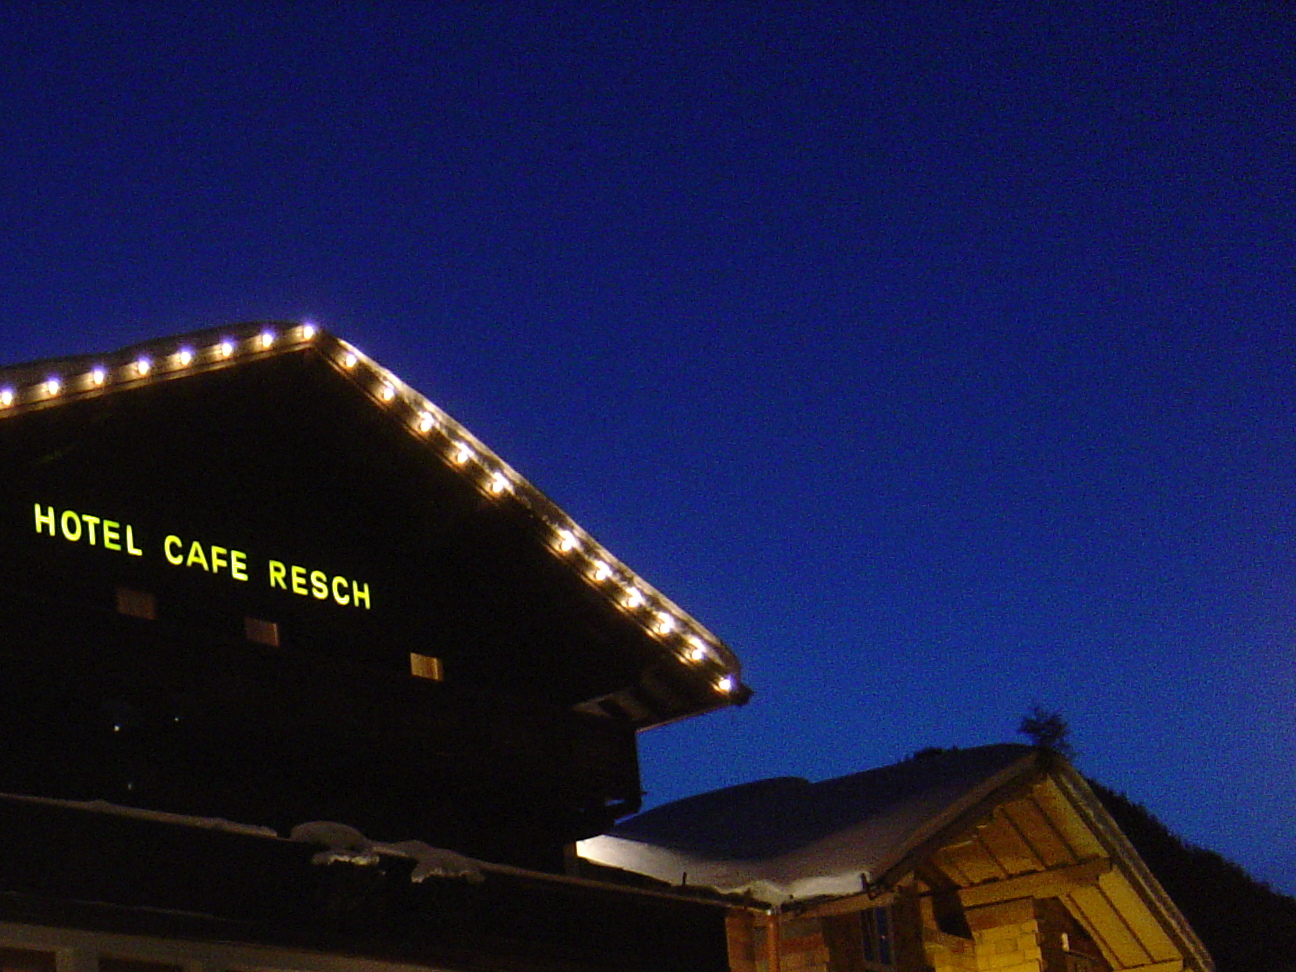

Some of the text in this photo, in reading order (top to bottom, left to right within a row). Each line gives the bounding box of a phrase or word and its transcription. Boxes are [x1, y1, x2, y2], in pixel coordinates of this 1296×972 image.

[34, 502, 371, 610] HOTEL CAFE RESCH
